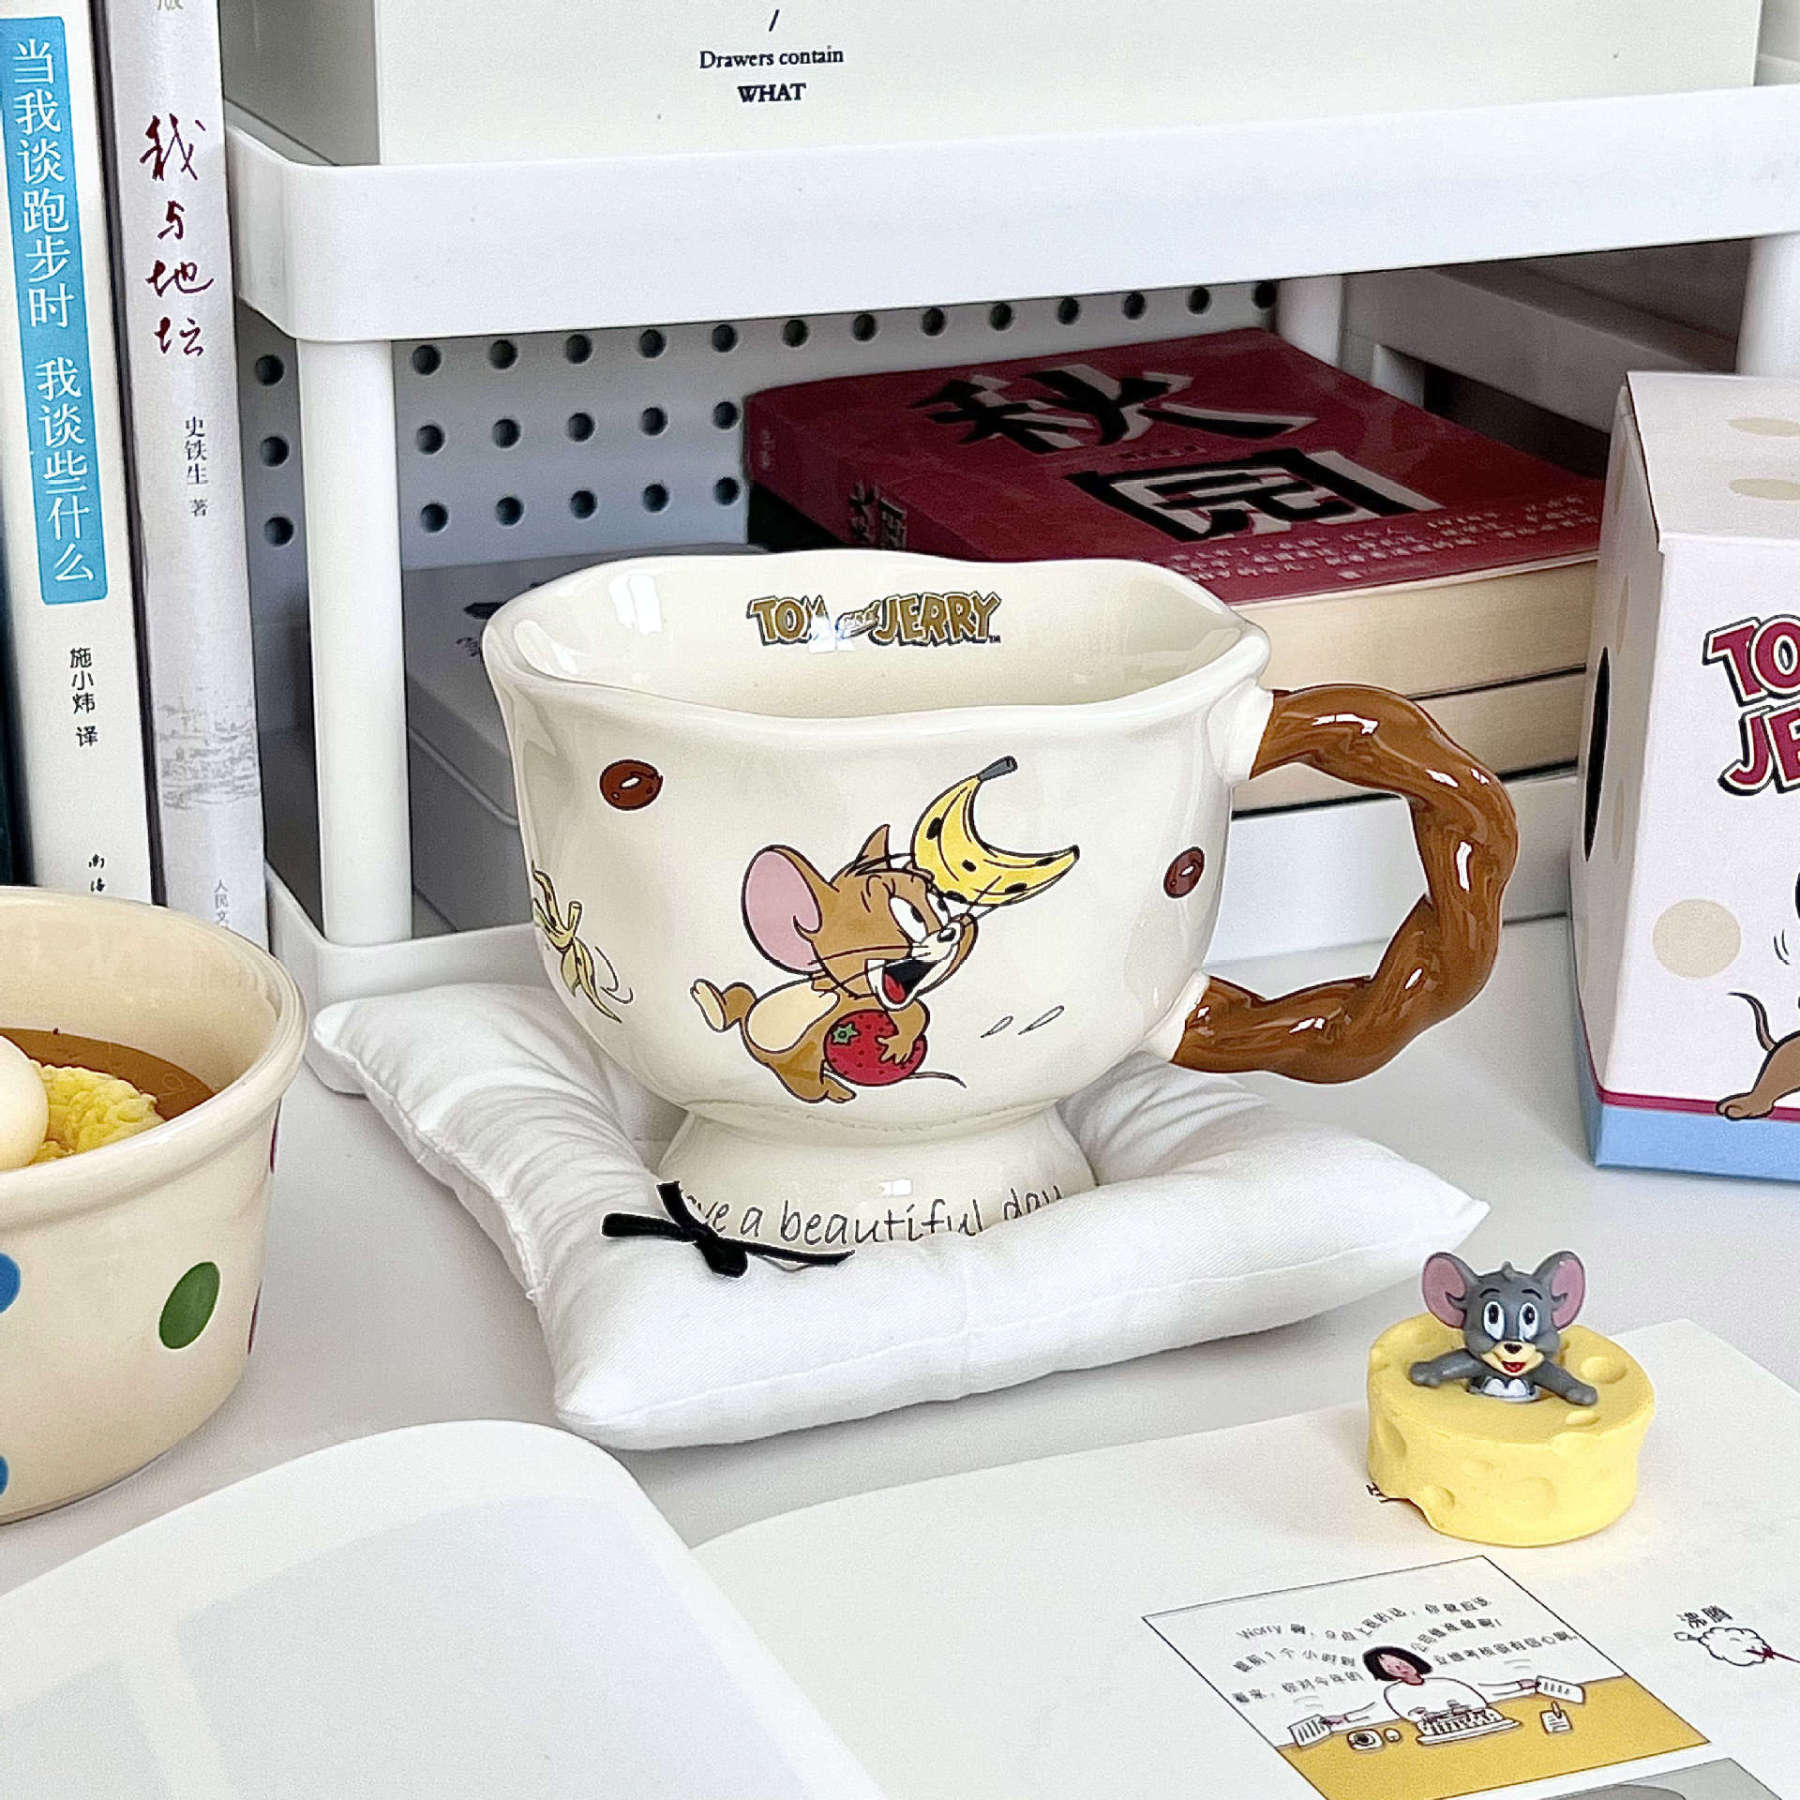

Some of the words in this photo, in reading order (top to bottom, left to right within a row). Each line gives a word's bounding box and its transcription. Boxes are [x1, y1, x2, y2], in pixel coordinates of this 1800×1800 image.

[700, 50, 775, 69] Drawers
[779, 45, 844, 65] contain
[737, 82, 807, 103] WHAT
[13, 38, 74, 328] 当我谈跑步时
[140, 113, 215, 357] 我与地坛
[36, 357, 94, 583] 我谈些什么
[185, 416, 210, 486] 史铁生
[190, 499, 208, 517] 著
[868, 590, 1001, 647] JERRY
[70, 647, 95, 713] 施小炜
[76, 726, 98, 747] 译
[740, 1206, 761, 1237] a
[780, 1198, 984, 1245] beautiful
